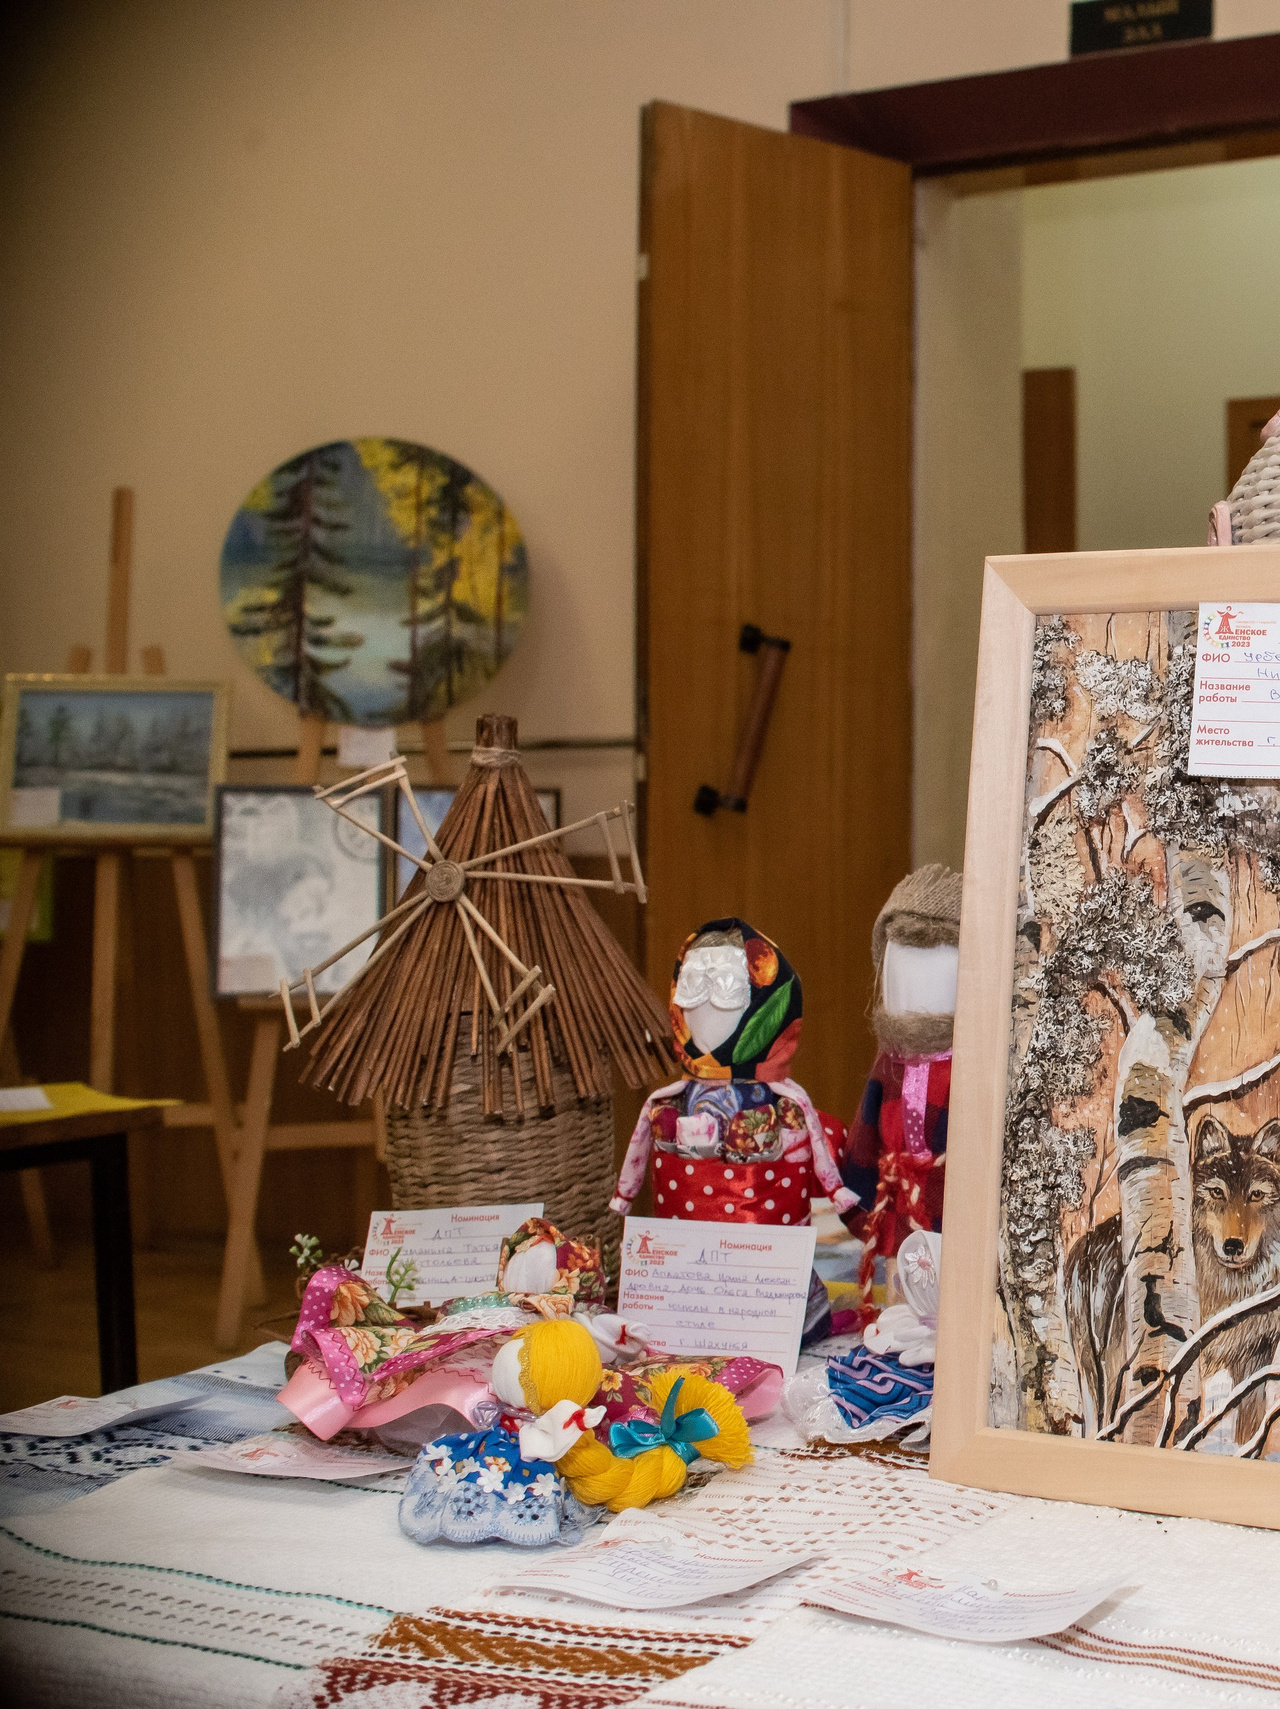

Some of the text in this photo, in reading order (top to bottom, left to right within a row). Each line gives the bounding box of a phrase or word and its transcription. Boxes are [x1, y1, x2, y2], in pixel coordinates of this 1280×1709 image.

[1202, 653, 1231, 663] ФИО
[1199, 680, 1251, 691] Название
[1198, 693, 1238, 704] работы
[1197, 724, 1230, 735] Место
[1195, 738, 1254, 747] жительства
[451, 1213, 500, 1223] Номинация
[719, 1239, 773, 1251] Номинация
[695, 1249, 732, 1265] ДПТ
[625, 1268, 649, 1278] ФИО
[623, 1291, 665, 1300] Название
[622, 1301, 654, 1310] работы
